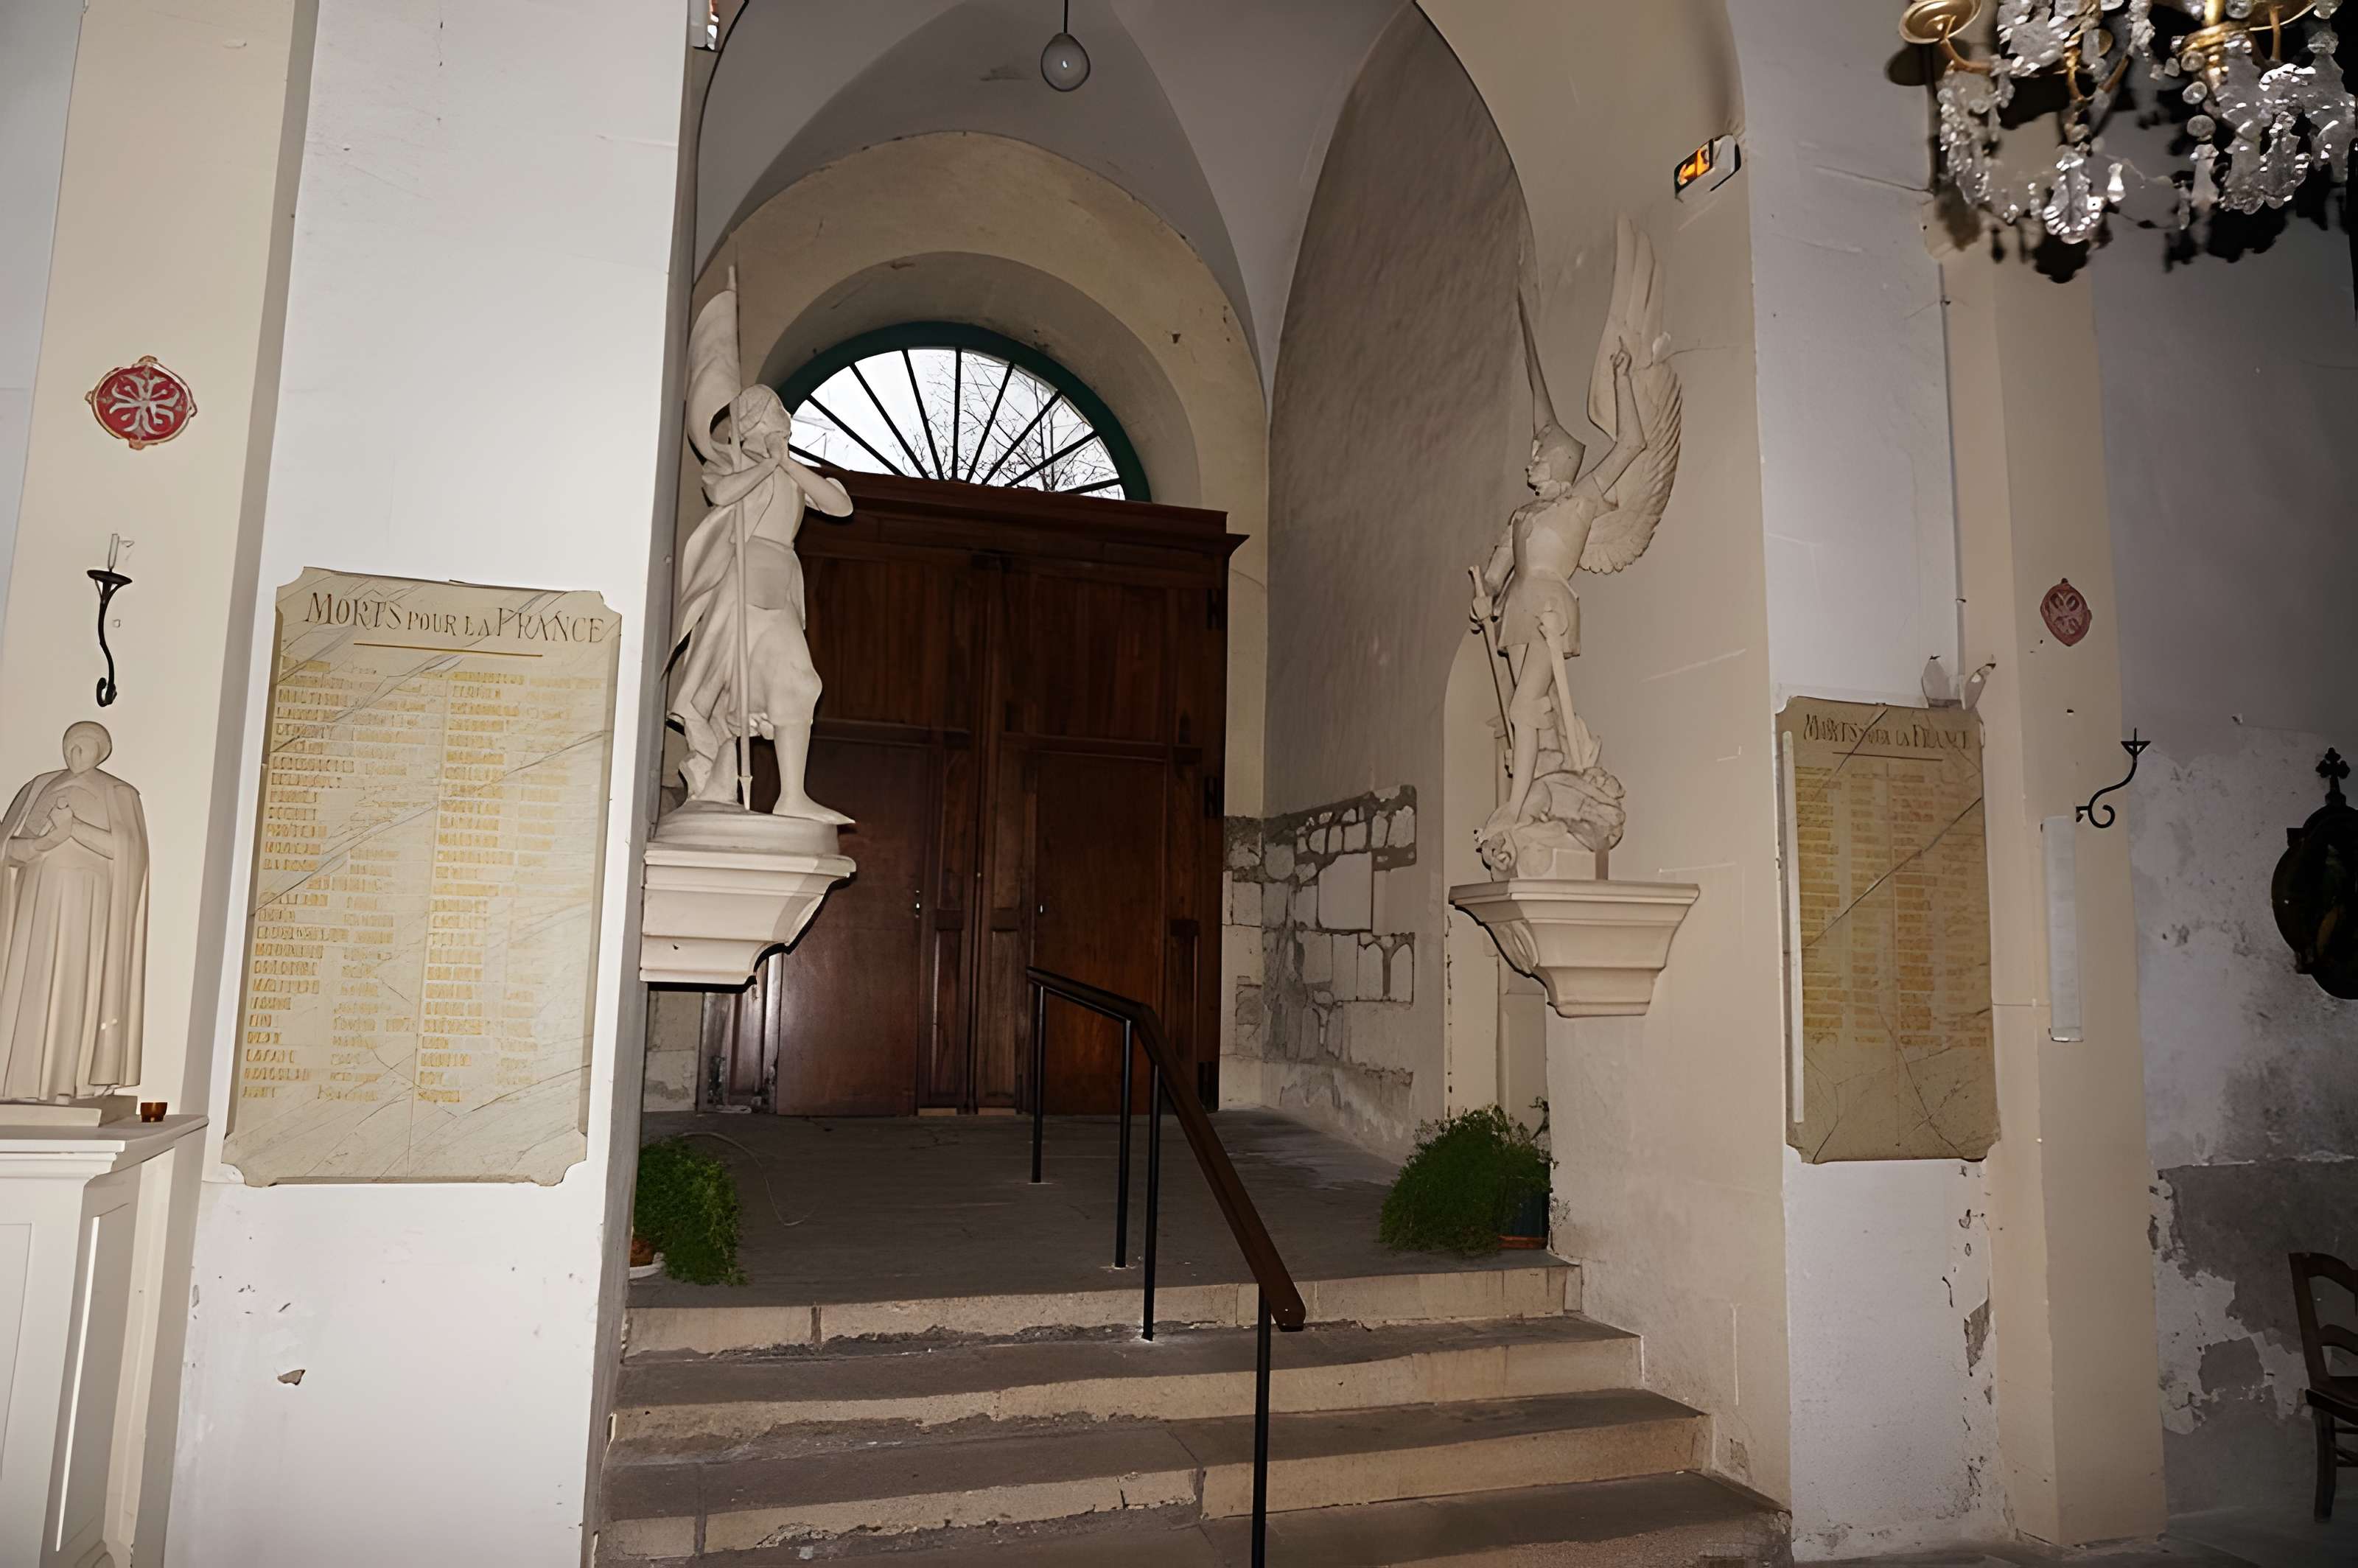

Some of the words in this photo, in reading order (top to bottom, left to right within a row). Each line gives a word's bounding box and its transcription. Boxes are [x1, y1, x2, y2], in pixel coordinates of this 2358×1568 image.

[305, 592, 403, 630] MORTS
[407, 611, 457, 637] POUR
[465, 615, 490, 637] LA
[497, 607, 605, 643] FRANCE
